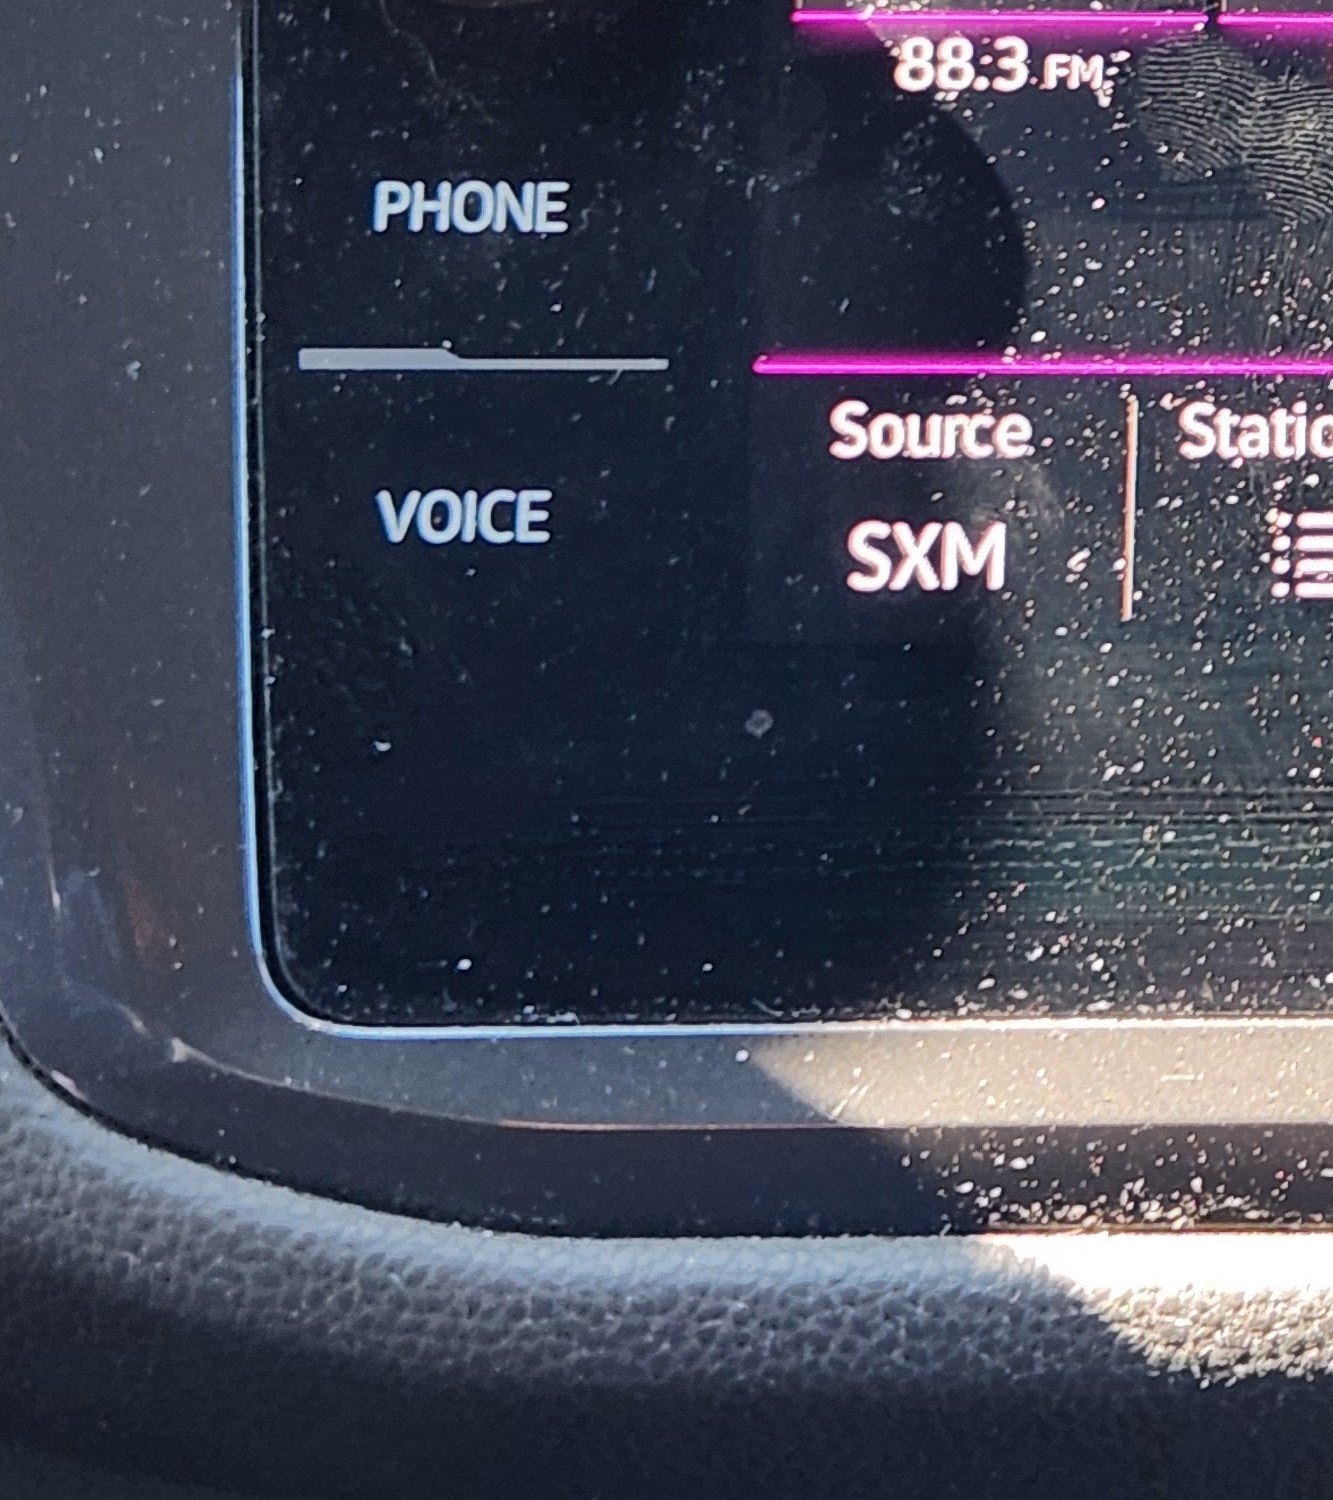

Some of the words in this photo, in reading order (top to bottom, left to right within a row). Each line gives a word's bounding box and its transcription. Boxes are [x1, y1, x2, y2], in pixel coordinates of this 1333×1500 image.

[892, 35, 1030, 92] 88.3
[373, 180, 571, 234] PHONE
[827, 399, 1035, 461] Source
[375, 488, 553, 544] VOICE
[845, 520, 1007, 592] SXM
